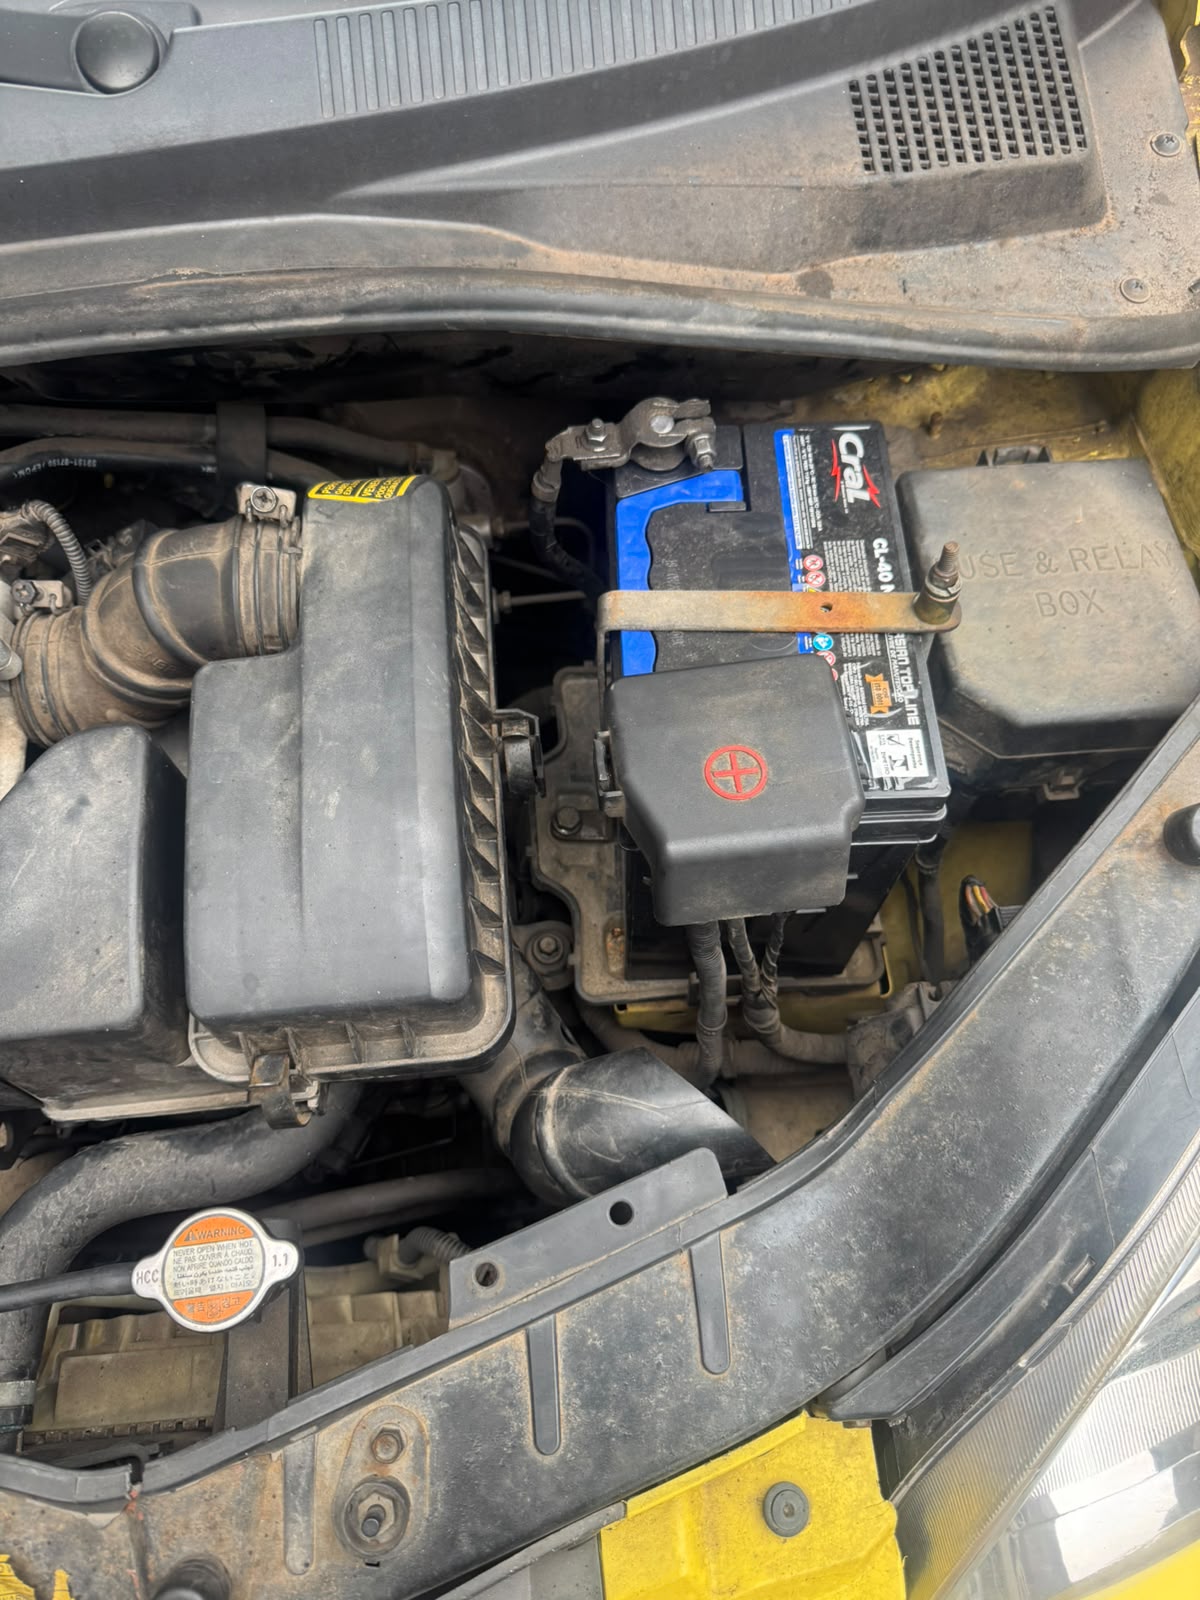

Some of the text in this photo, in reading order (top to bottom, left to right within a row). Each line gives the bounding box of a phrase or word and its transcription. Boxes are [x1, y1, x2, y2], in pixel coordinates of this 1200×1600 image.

[872, 537, 895, 583] CL-40
[957, 542, 1173, 581] USE & RELAY
[1035, 588, 1104, 618] BOX
[904, 695, 922, 726] LINE
[198, 1225, 246, 1240] WARNING
[173, 1248, 195, 1257] NEVER
[197, 1245, 215, 1254] OPEN
[216, 1242, 237, 1251] WHEN
[184, 1255, 197, 1263] PAS
[198, 1252, 222, 1261] OUVRIR
[173, 1255, 254, 1273] NON APRIRE QUANDO CALDO
[272, 1253, 289, 1268] 1.1
[136, 1268, 160, 1285] HCC
